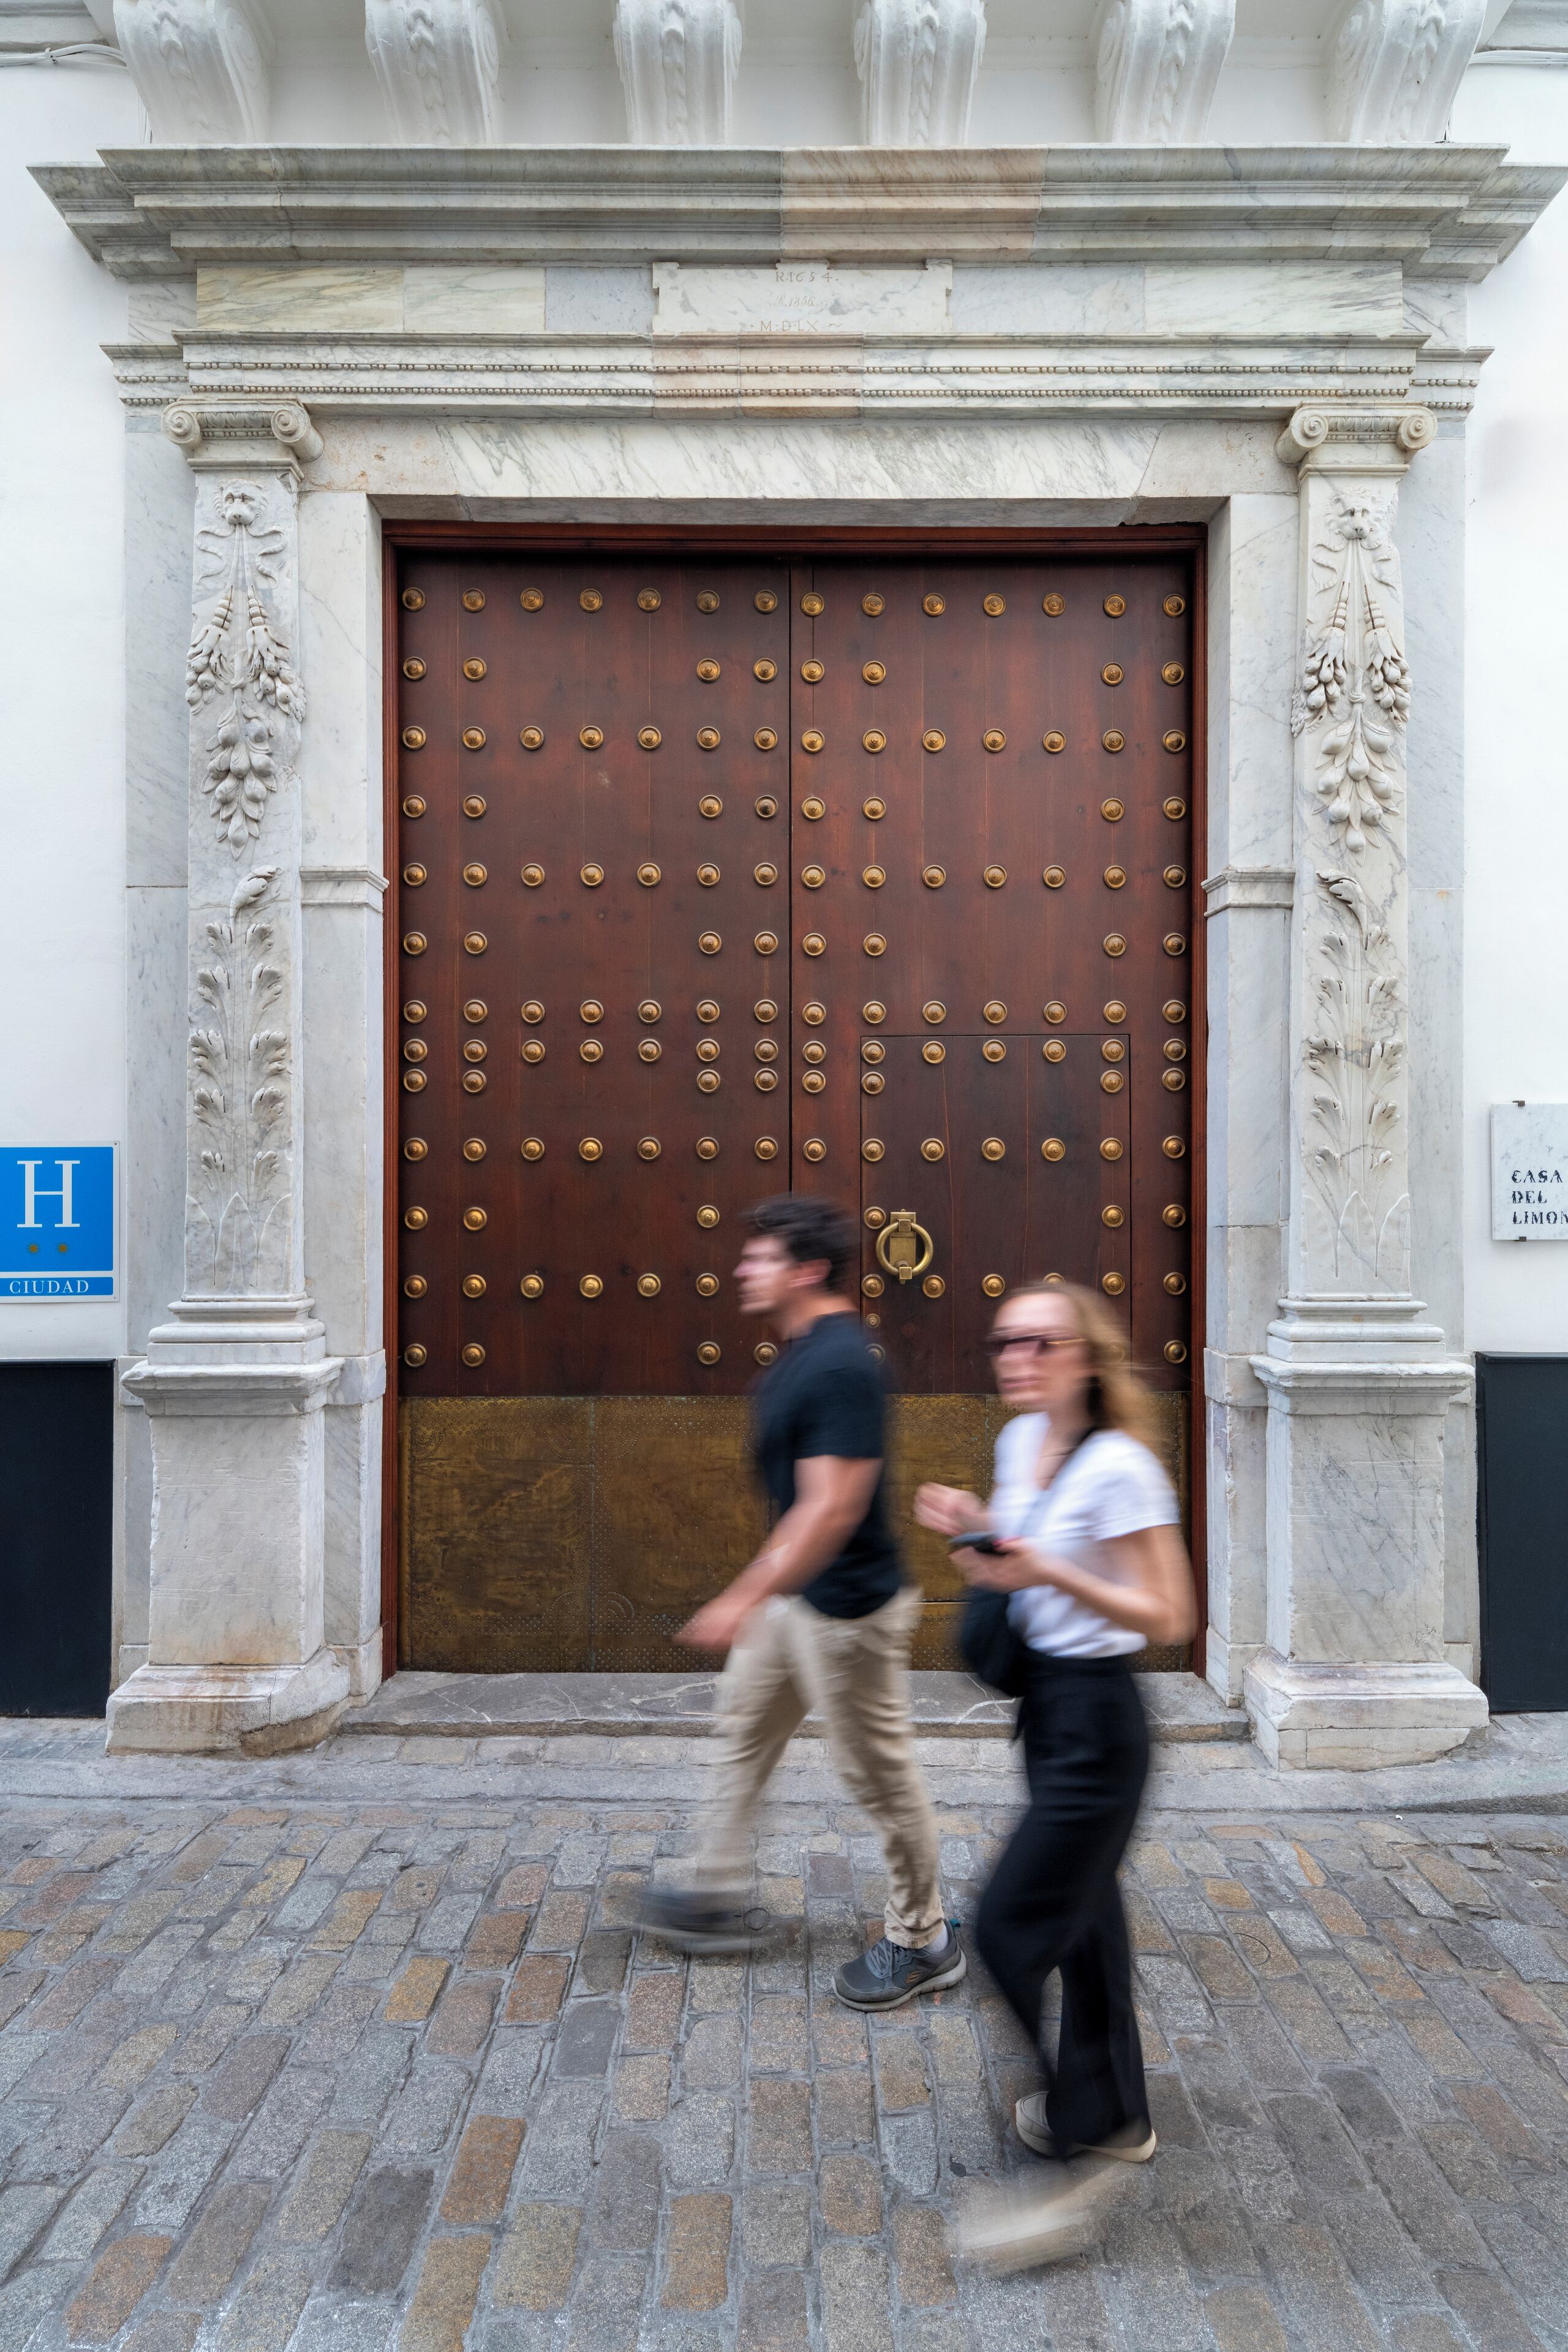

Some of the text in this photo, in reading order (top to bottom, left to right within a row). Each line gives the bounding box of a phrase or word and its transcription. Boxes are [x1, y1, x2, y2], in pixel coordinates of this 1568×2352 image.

[1511, 1170, 1563, 1183] CASA
[17, 1160, 80, 1227] H
[1512, 1191, 1547, 1204] DEL
[9, 1280, 89, 1294] CIUDAD
